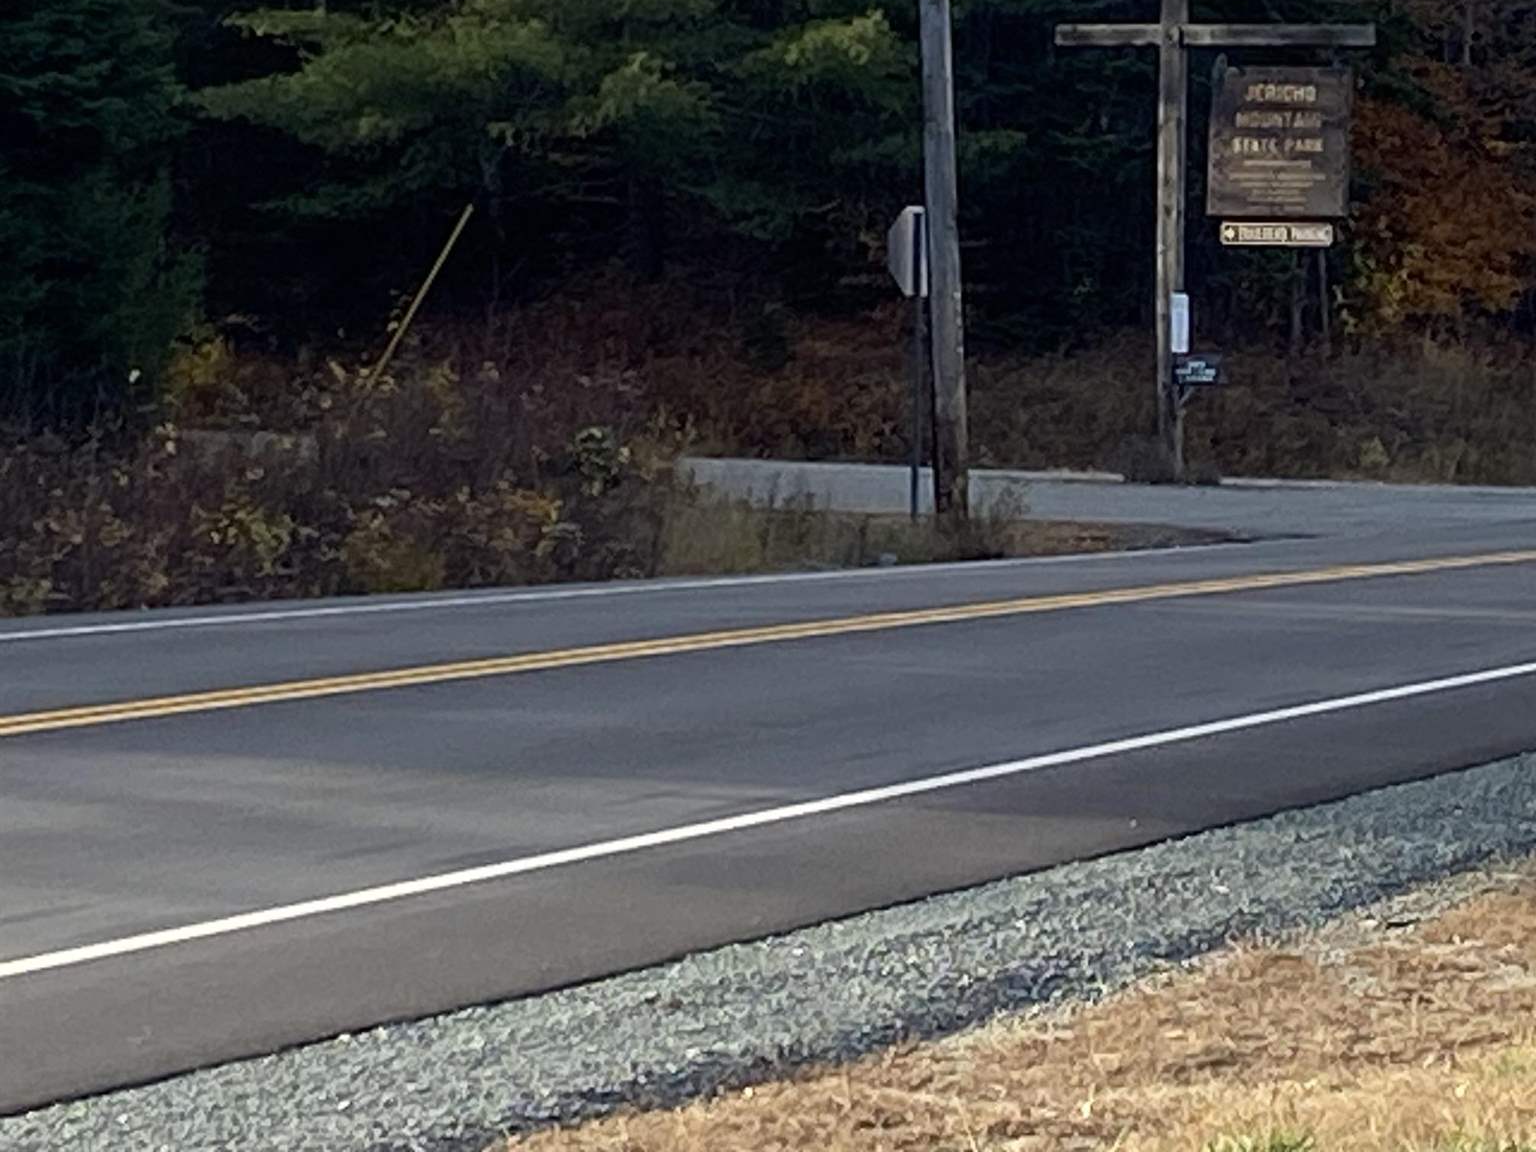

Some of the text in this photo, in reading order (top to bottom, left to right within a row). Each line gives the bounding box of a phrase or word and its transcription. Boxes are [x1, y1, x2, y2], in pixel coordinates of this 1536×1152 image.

[1245, 83, 1317, 102] JERICHO
[1231, 137, 1324, 153] STATE PARK
